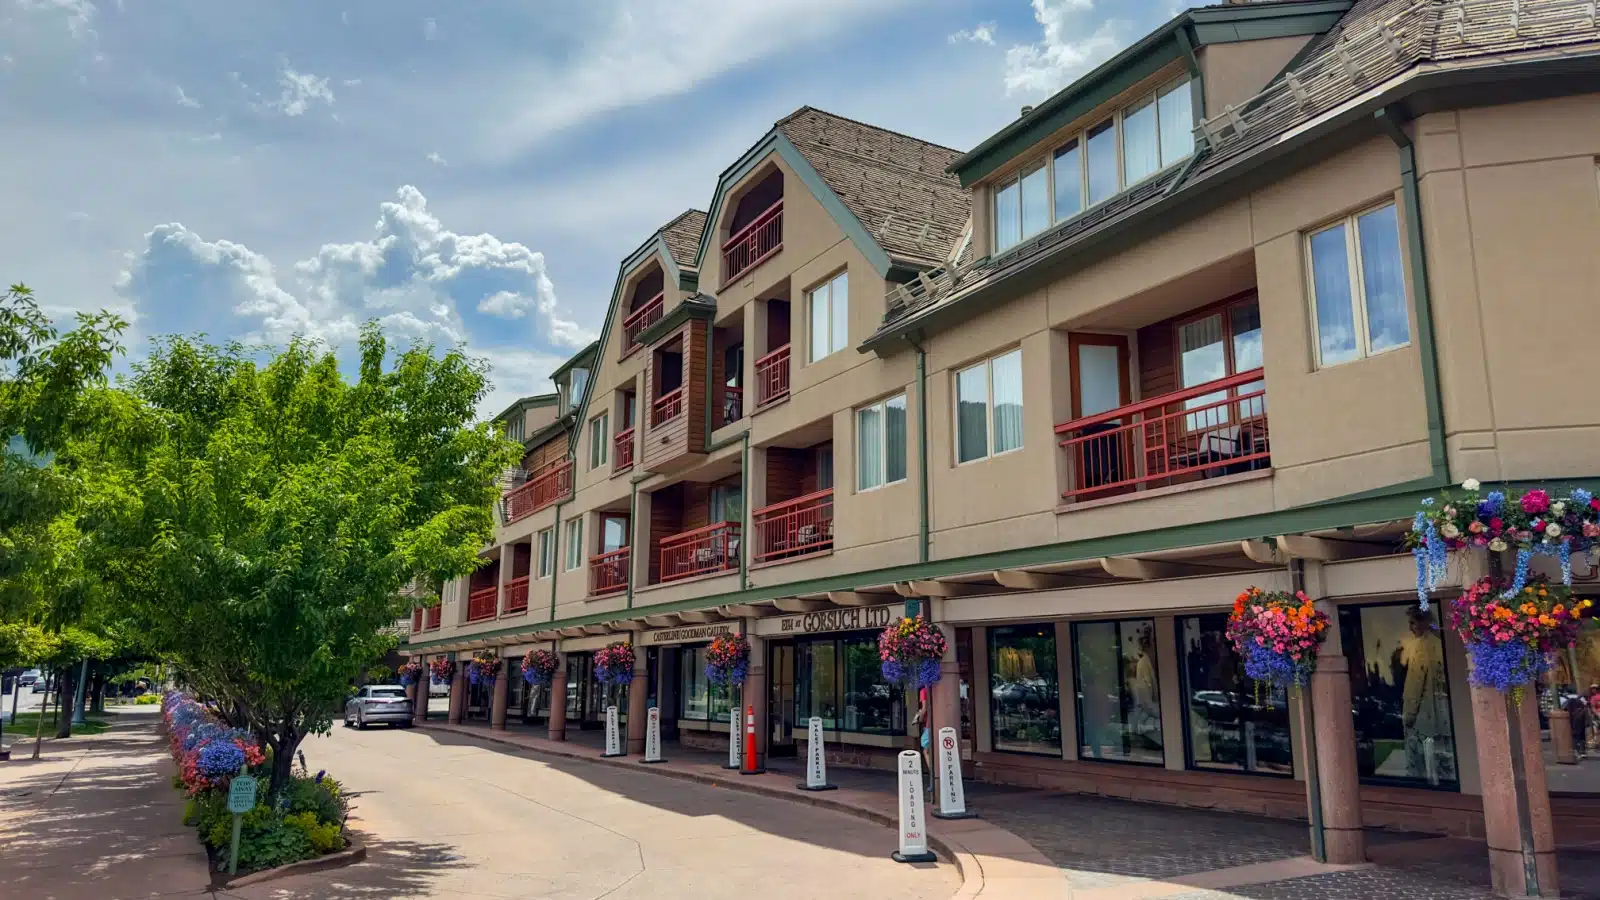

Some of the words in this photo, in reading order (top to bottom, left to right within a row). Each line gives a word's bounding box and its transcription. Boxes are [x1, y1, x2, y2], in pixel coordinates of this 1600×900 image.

[803, 607, 860, 632] GORSUCH
[865, 605, 890, 628] LTD
[908, 760, 913, 768] 2
[947, 751, 952, 762] NO
[948, 765, 956, 803] PARKING
